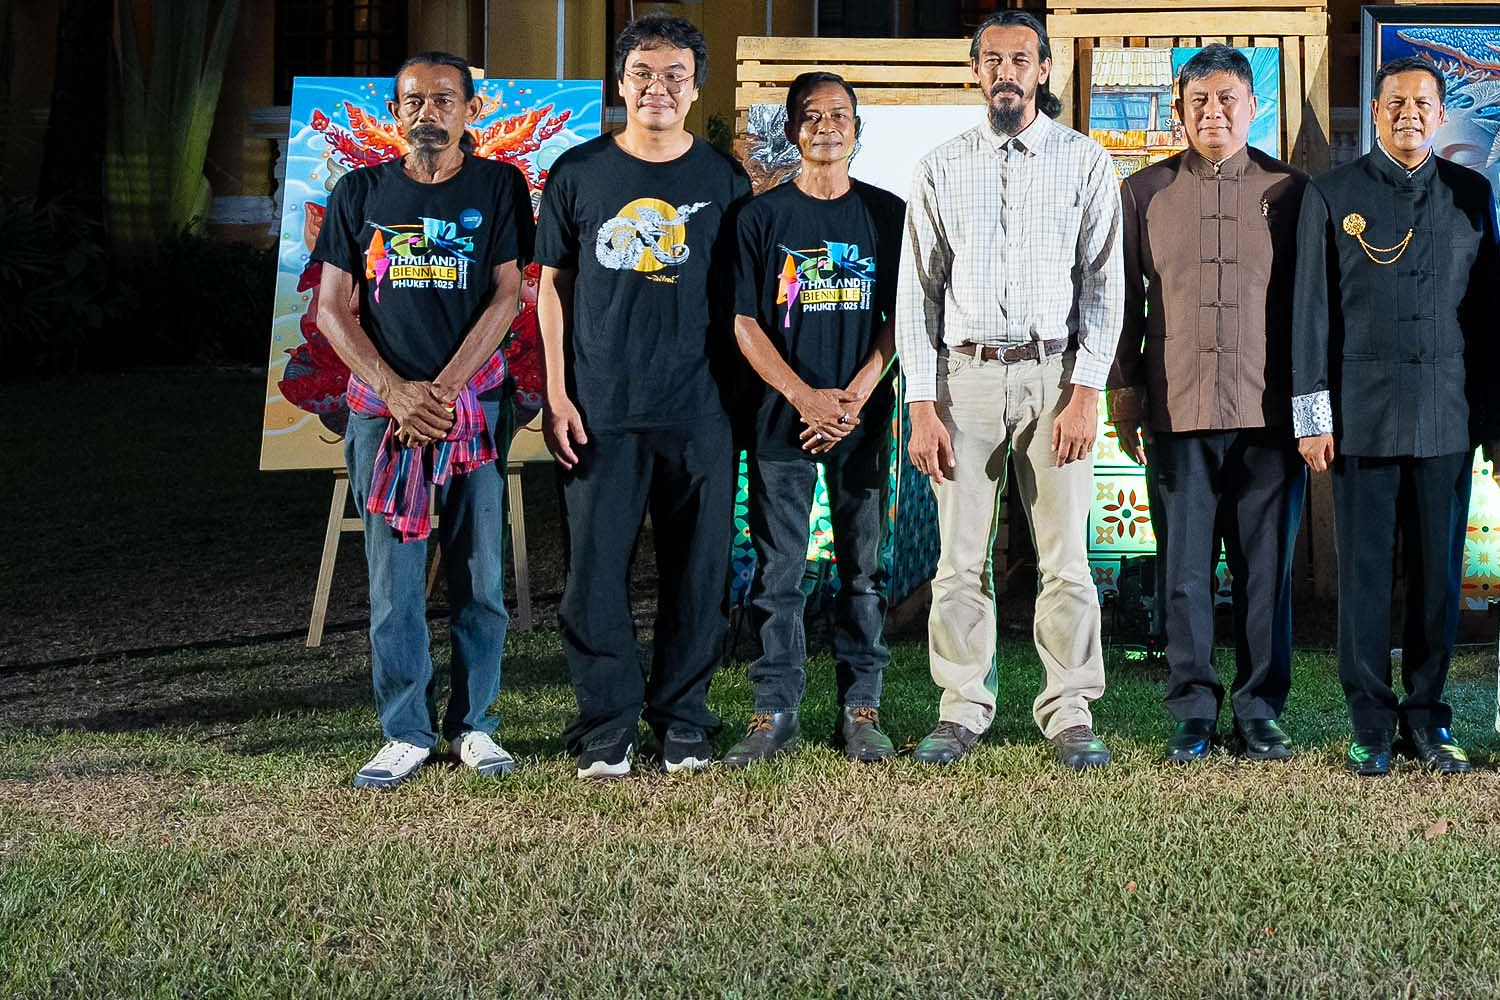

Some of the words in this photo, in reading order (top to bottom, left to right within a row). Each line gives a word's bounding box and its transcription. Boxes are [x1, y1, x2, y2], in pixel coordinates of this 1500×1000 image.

[391, 255, 457, 267] THAILAND
[392, 267, 454, 279] BIENNALE
[392, 280, 430, 289] PHUKET
[433, 280, 454, 289] 2025
[800, 277, 860, 290] THAILAND
[803, 290, 858, 301] BIENNALE
[803, 302, 837, 312] PHUKET
[839, 302, 858, 311] 2025
